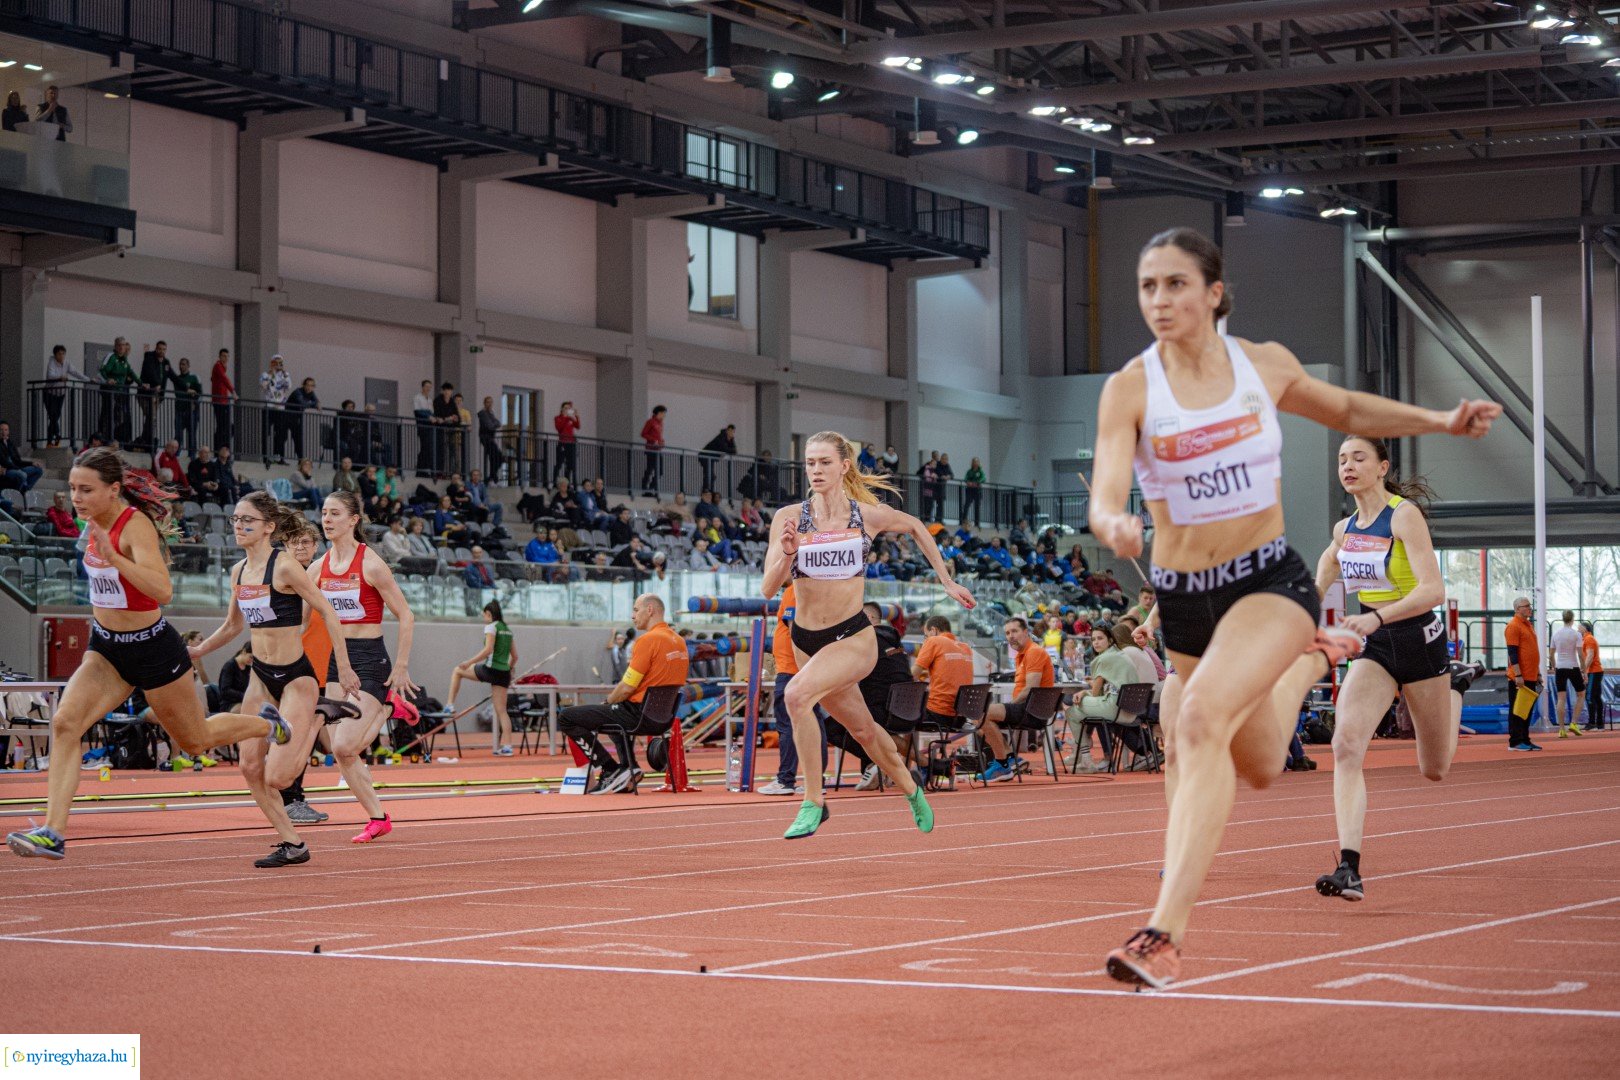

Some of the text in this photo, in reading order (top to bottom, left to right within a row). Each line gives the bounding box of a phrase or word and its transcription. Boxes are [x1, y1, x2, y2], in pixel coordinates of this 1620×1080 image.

[1184, 461, 1252, 501] CSÓTI
[805, 549, 856, 568] HUSZKA
[1186, 551, 1253, 592] NIKE
[114, 629, 151, 643] NIKE
